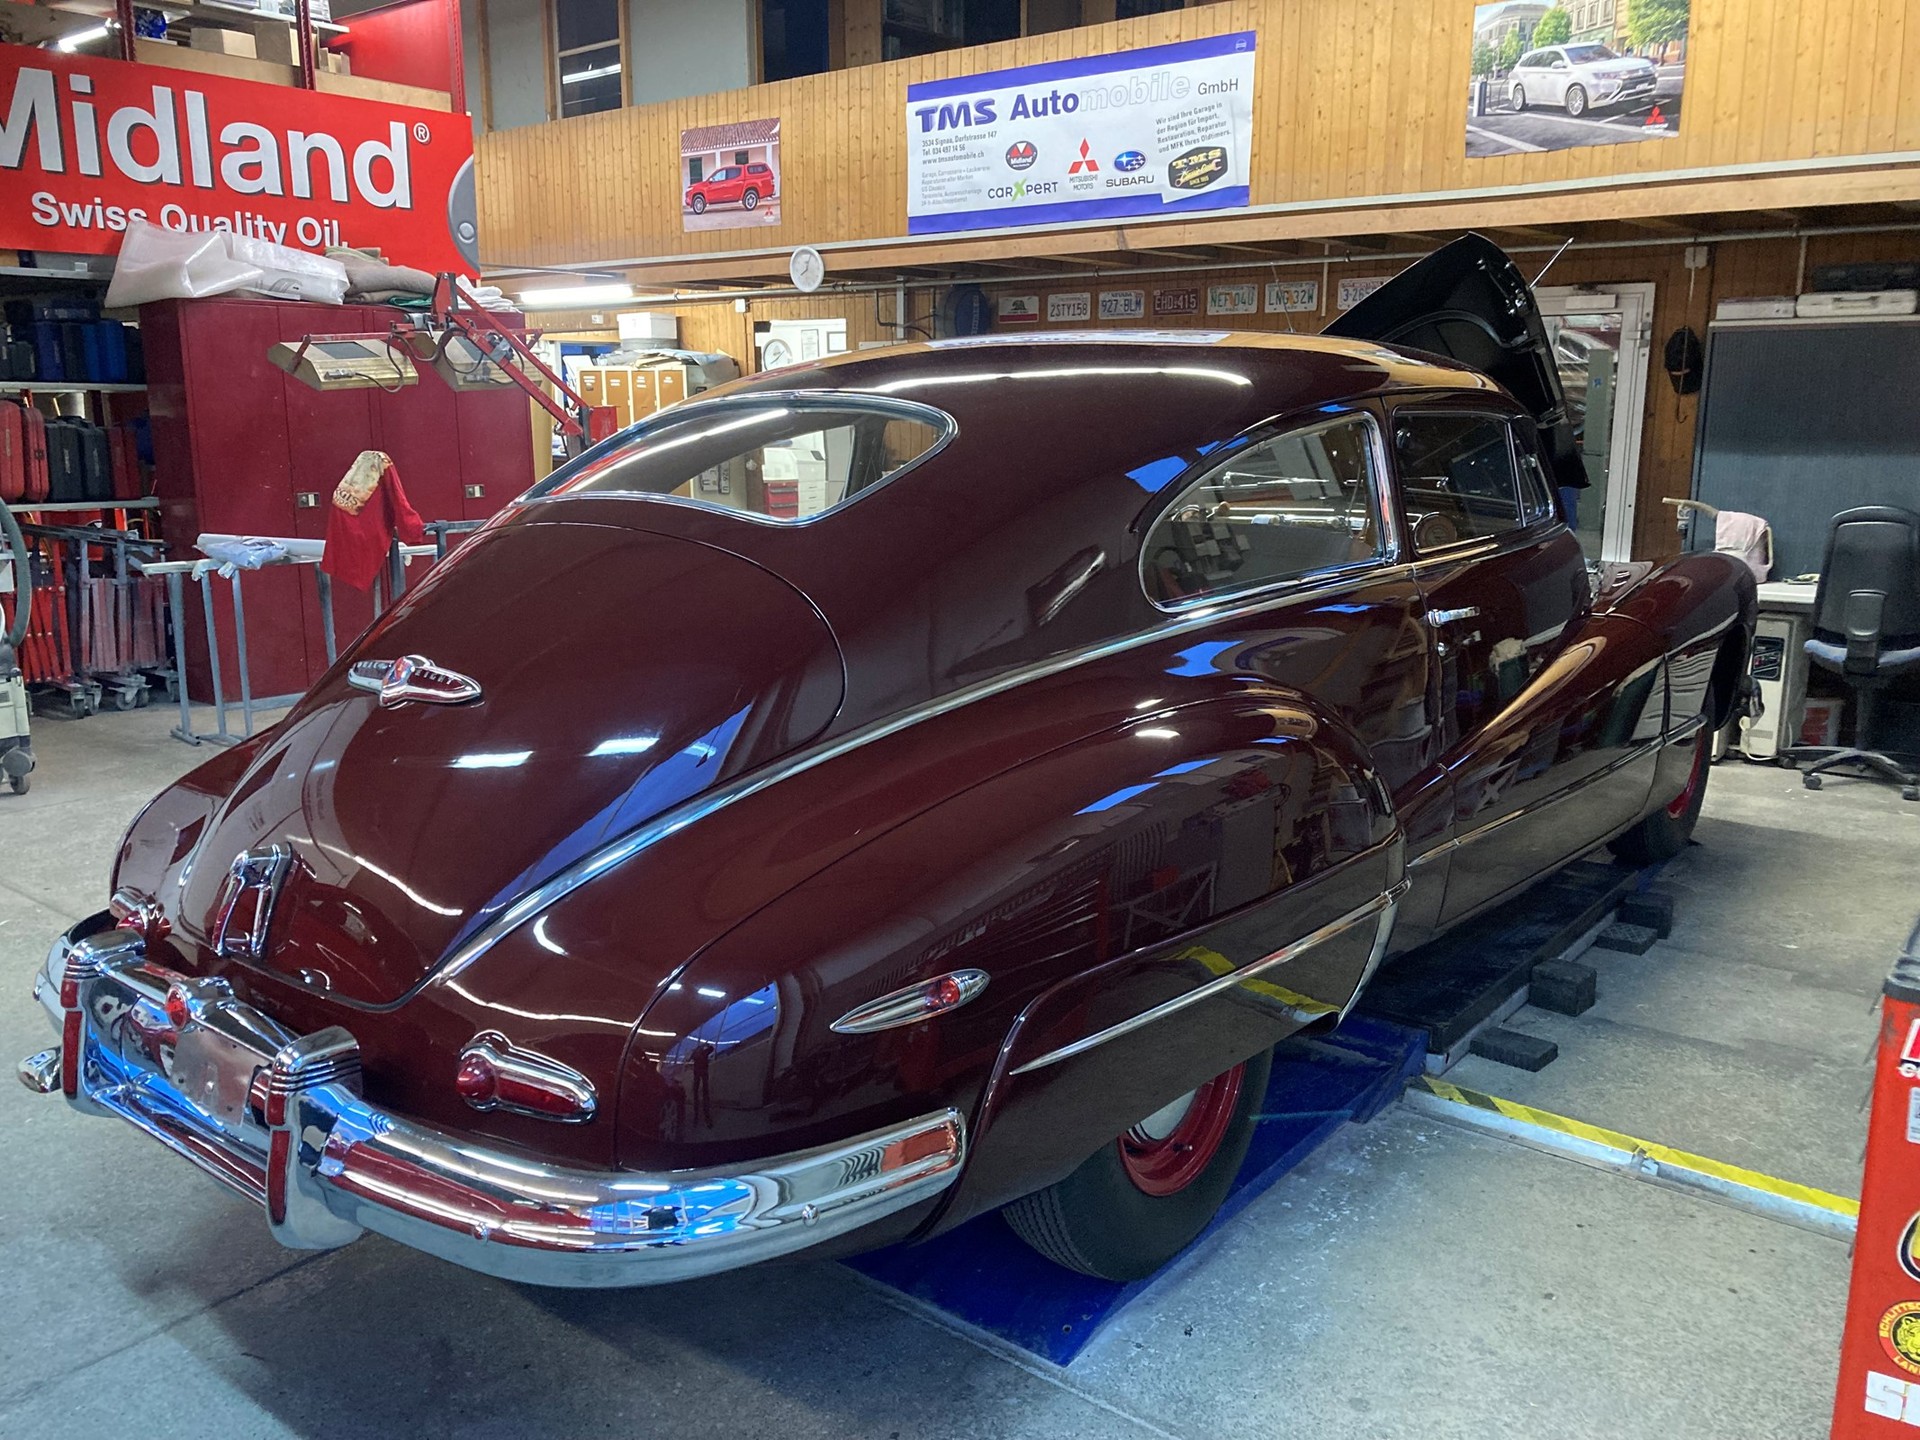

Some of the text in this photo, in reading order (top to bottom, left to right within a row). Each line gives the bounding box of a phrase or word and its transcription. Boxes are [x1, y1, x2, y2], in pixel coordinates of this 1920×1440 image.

[915, 72, 1239, 133] TMS Automobile GmbH
[1167, 112, 1180, 123] sind
[1180, 110, 1193, 119] Ihre
[1193, 104, 1215, 115] Garage
[987, 130, 998, 139] 147
[1156, 127, 1166, 135] der
[1166, 121, 1187, 132] Region
[1170, 141, 1184, 150] MFK
[1184, 137, 1200, 146] Ihres
[1106, 175, 1155, 188] SUBARU
[31, 192, 147, 231] Swiss
[160, 203, 286, 246] Quality
[1050, 302, 1088, 318] 2STY158
